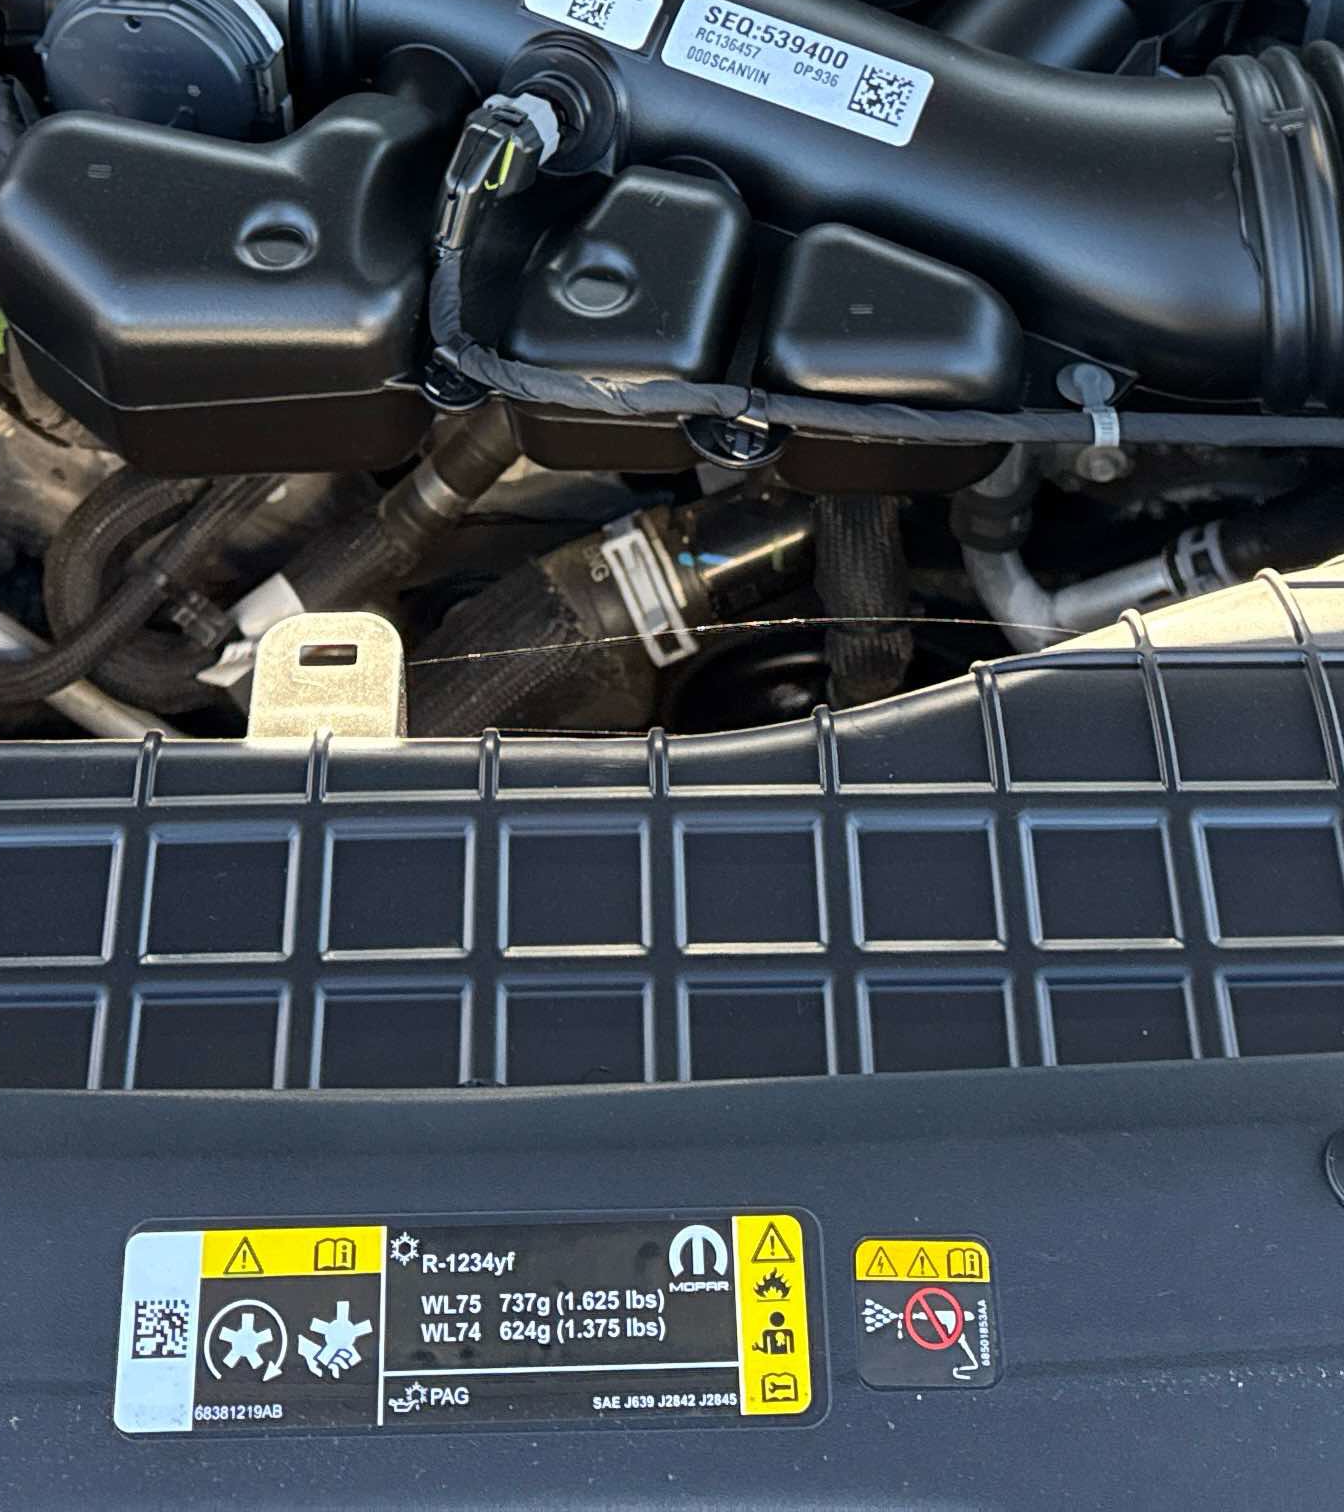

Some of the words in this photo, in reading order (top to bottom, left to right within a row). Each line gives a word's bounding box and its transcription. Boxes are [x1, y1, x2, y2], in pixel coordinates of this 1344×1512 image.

[695, 27, 762, 59] RC136457
[704, 5, 849, 70] SEQ:539400
[422, 1251, 516, 1276] R-1234yf
[669, 1280, 730, 1293] MOPAR
[421, 1294, 482, 1315] WL75
[499, 1292, 551, 1316] 737g
[556, 1291, 620, 1316] (1.625
[625, 1289, 666, 1313] lbs)
[421, 1321, 482, 1343] WL74
[499, 1320, 551, 1344] 624g
[556, 1318, 621, 1344] (1.375
[625, 1316, 666, 1342] lbs)
[430, 1386, 470, 1406] PAG
[592, 1396, 621, 1410] SAE
[624, 1395, 655, 1409] J639
[658, 1394, 696, 1408] J2842
[699, 1393, 738, 1407] J2845
[194, 1403, 283, 1421] 68381219AB
